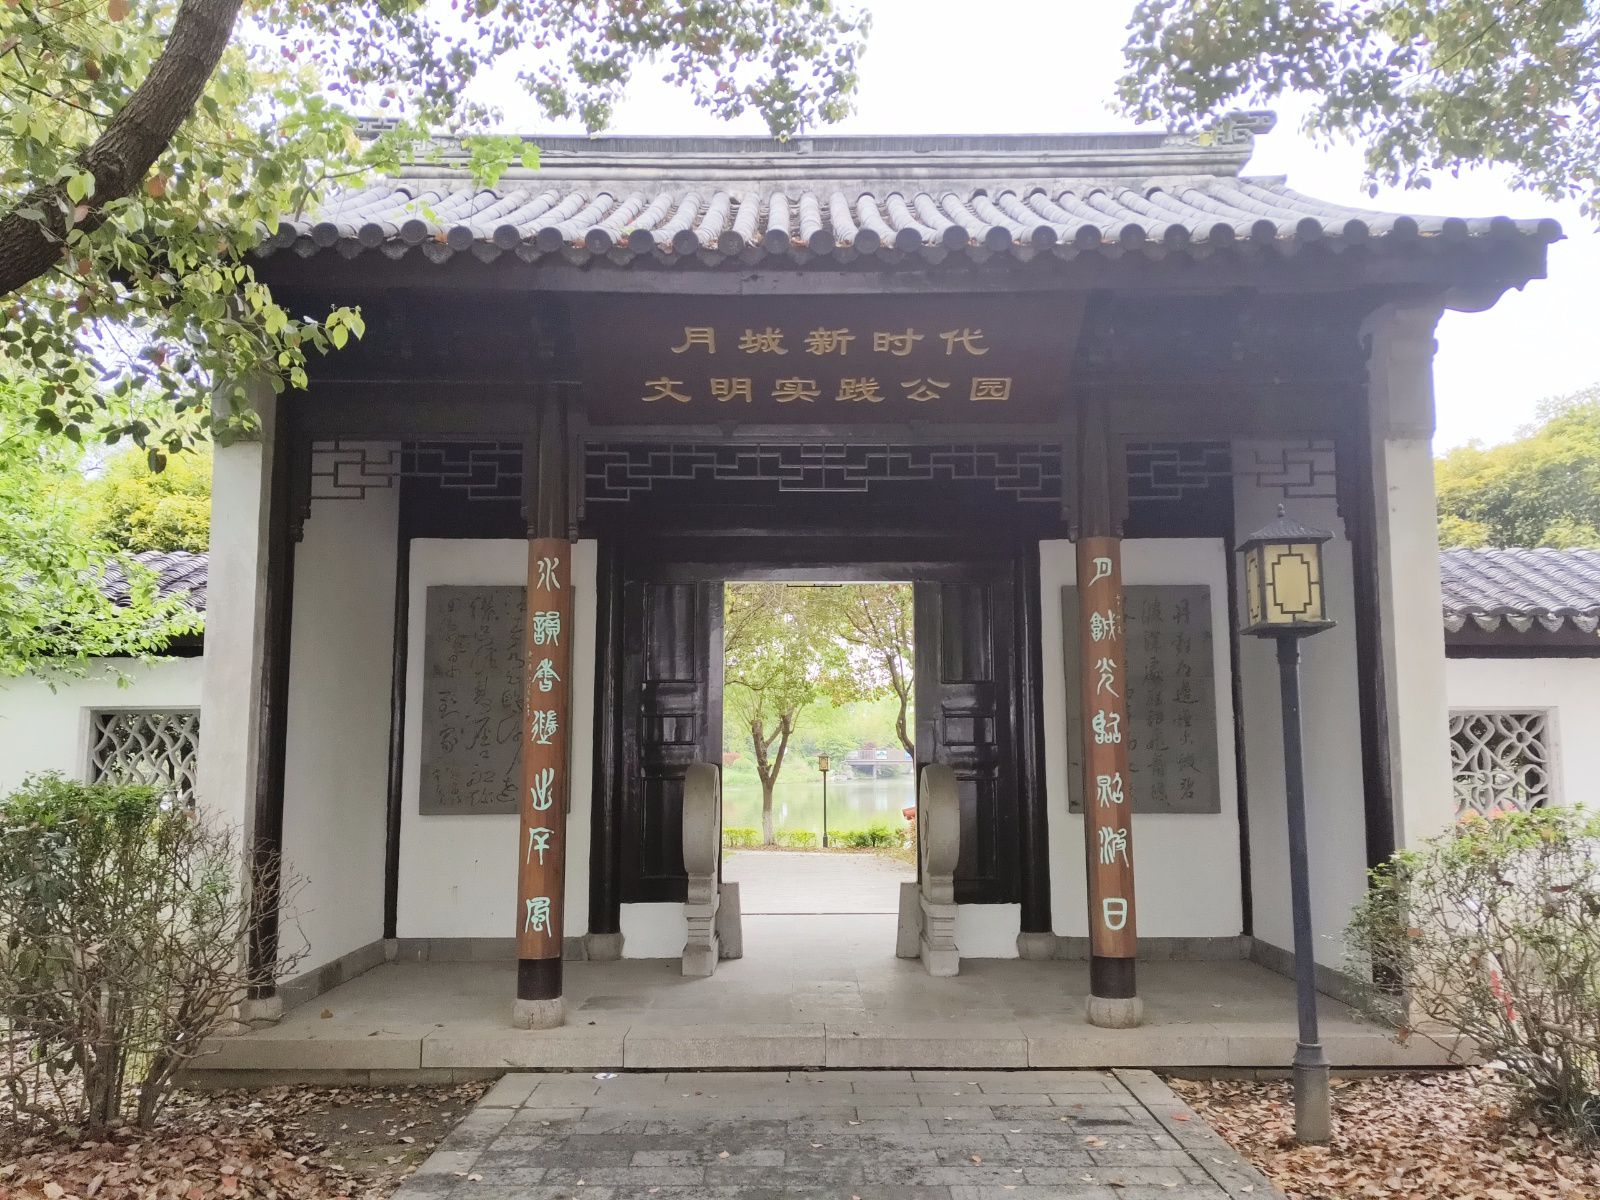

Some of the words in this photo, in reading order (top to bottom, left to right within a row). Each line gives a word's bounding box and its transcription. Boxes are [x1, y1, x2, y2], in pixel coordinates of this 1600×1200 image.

[670, 326, 991, 356] 月城新时代
[641, 376, 1013, 402] 文明实践公园
